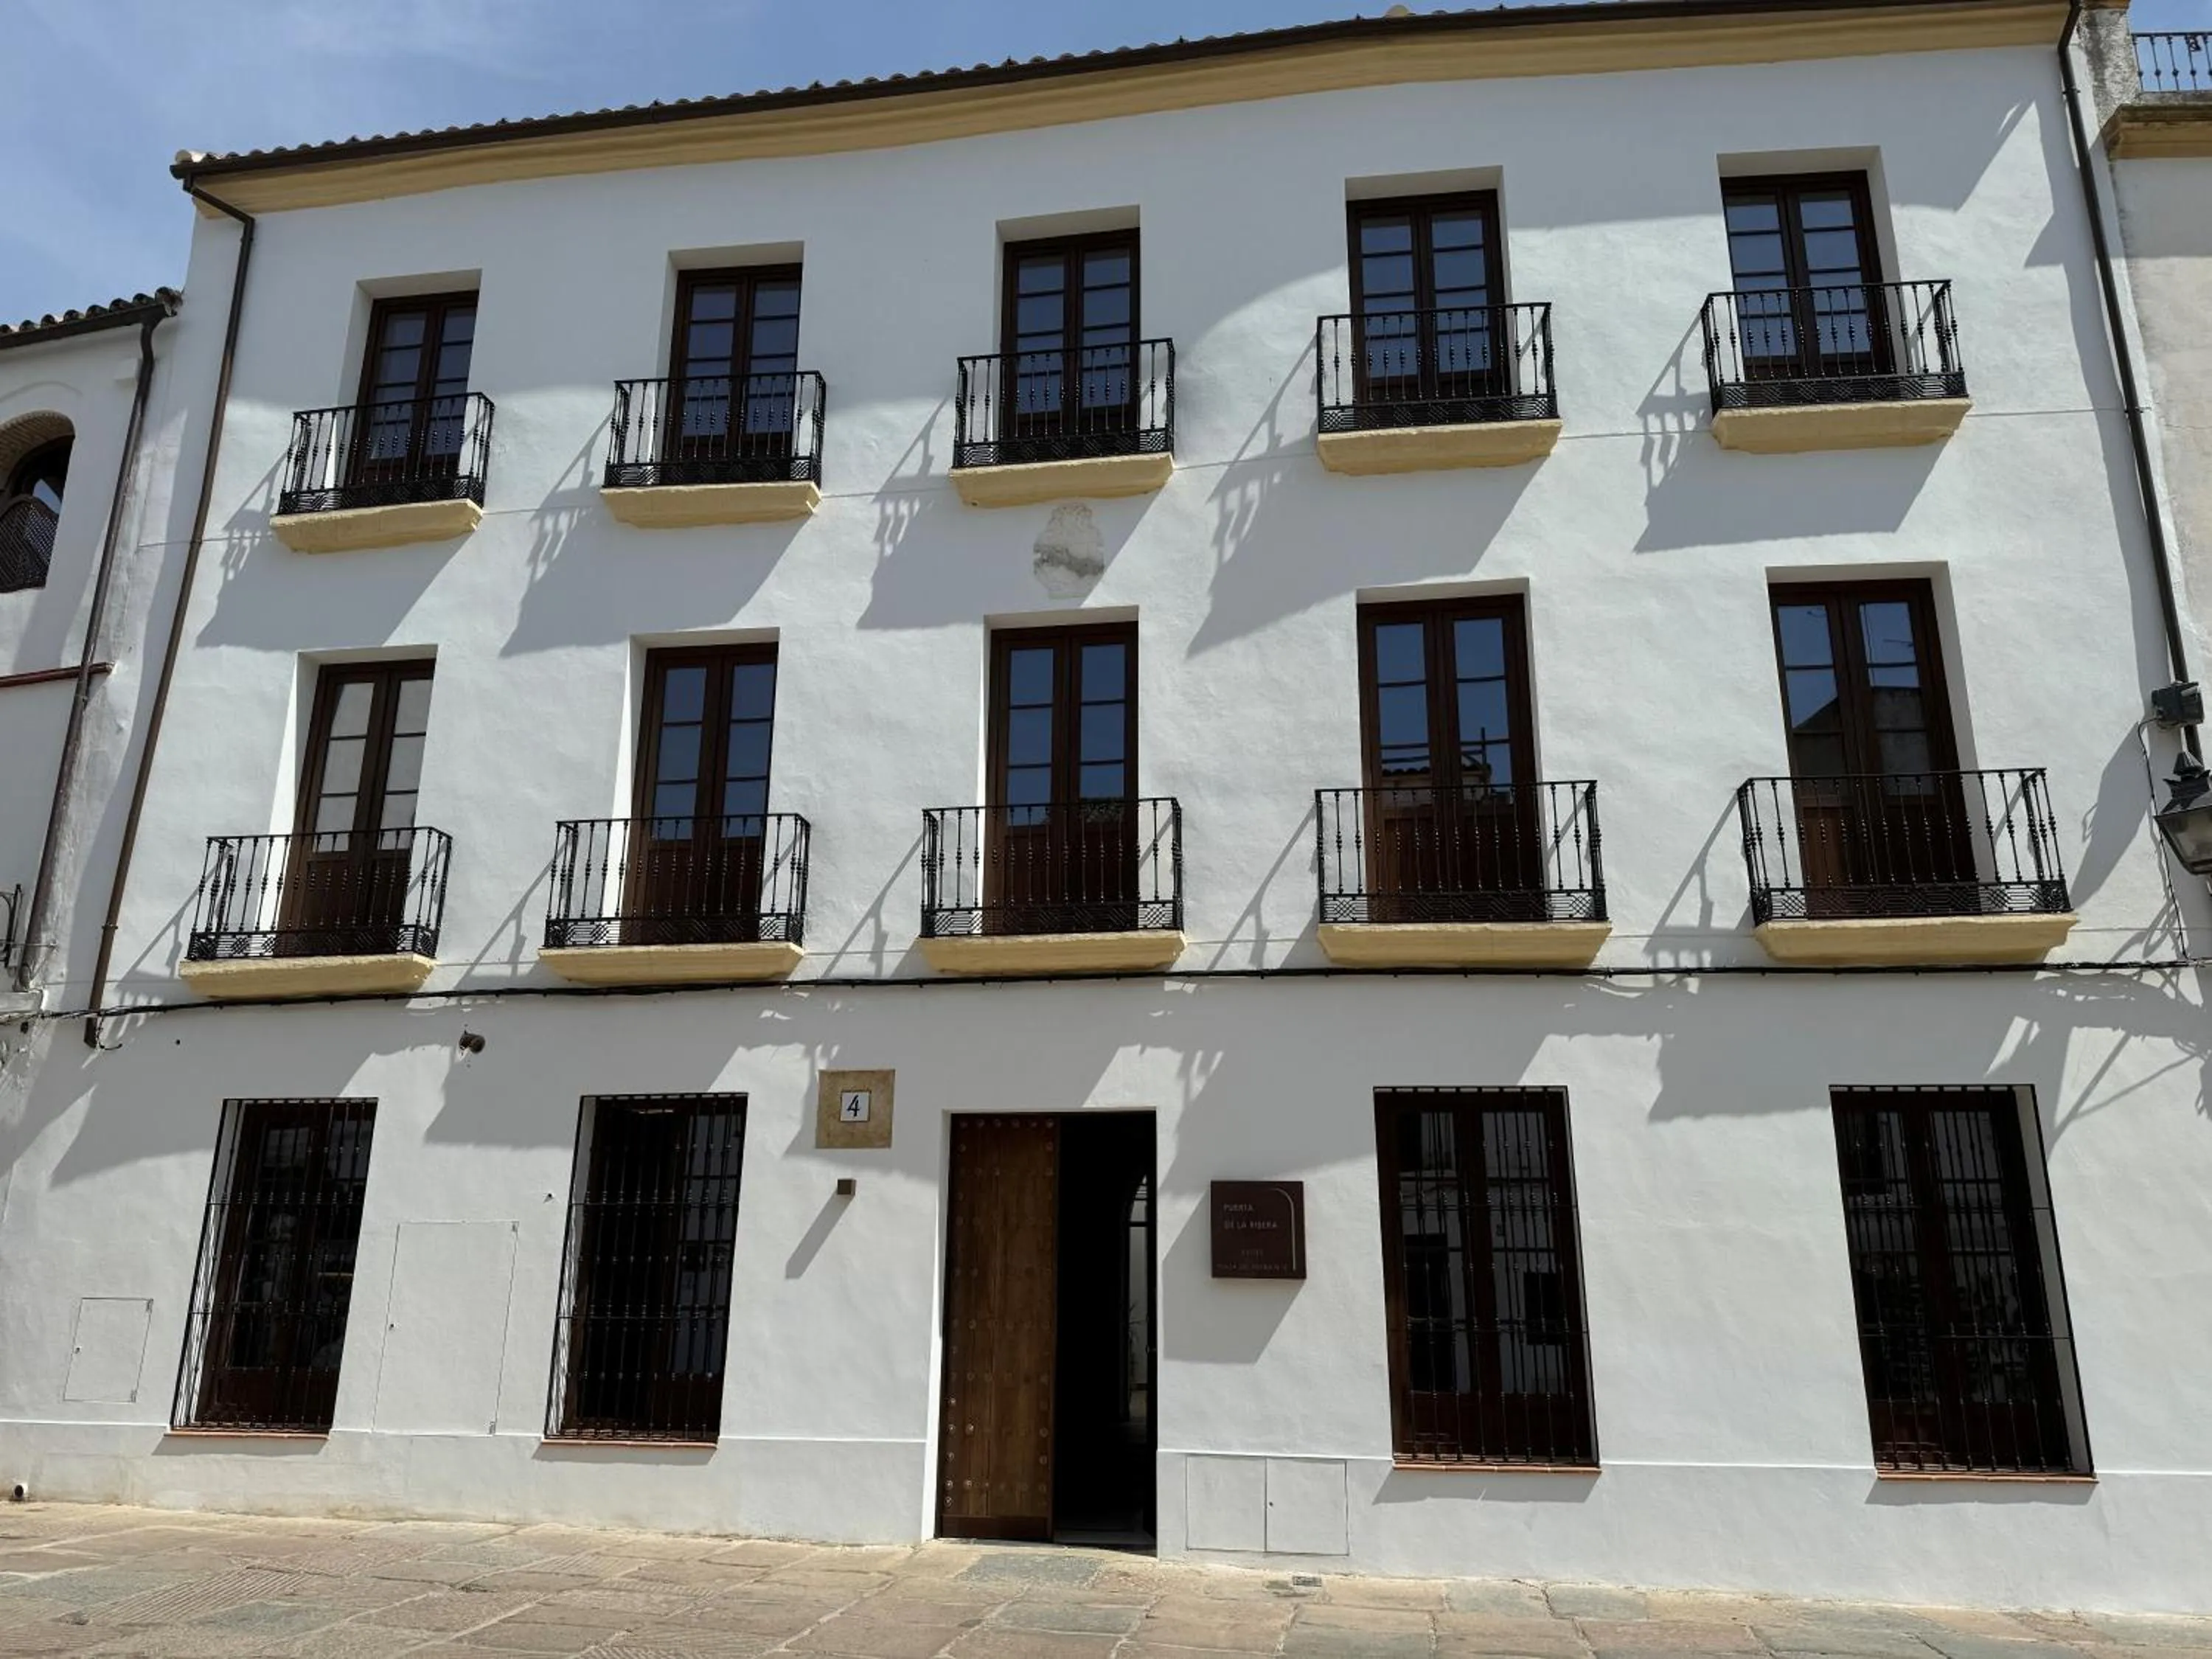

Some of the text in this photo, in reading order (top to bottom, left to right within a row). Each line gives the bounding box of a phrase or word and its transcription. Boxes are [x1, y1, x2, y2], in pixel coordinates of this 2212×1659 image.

[846, 1094, 860, 1117] 4
[1223, 1203, 1253, 1211] PUERTA
[1224, 1221, 1234, 1229] DE
[1237, 1221, 1247, 1229] LA
